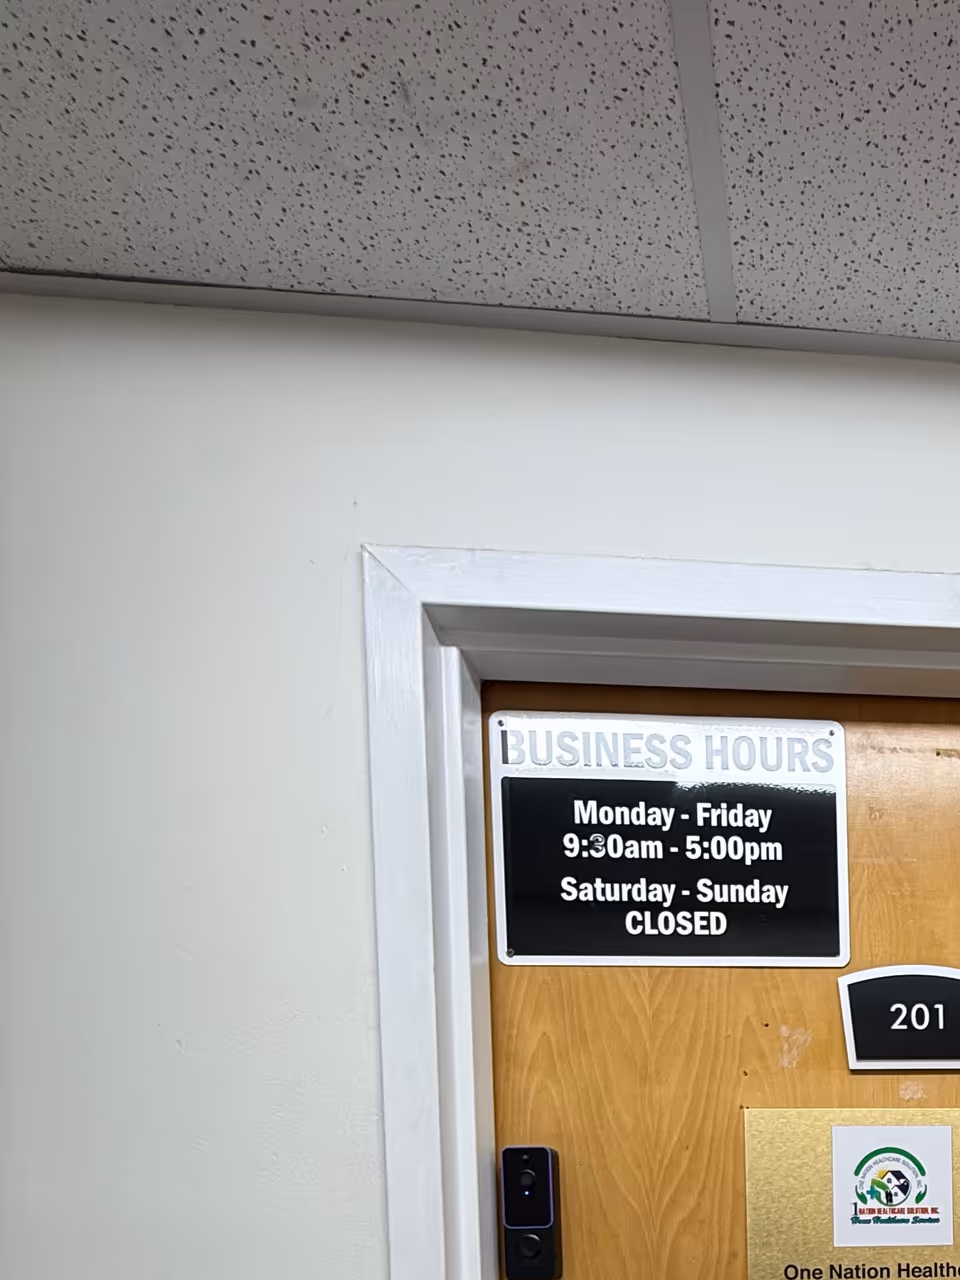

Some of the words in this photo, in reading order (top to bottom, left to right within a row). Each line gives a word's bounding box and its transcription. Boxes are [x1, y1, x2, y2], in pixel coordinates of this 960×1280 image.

[500, 729, 693, 770] BUSINESS
[705, 734, 834, 773] HOURS
[573, 800, 675, 831] Monday
[696, 802, 772, 833] Friday
[562, 833, 664, 860] 9:30am
[685, 836, 783, 865] 5:00pm
[560, 876, 676, 907] Saturday
[696, 878, 790, 909] Sunday
[625, 911, 728, 936] CLOSED
[889, 1003, 945, 1031] 201
[783, 1264, 824, 1280] One
[829, 1263, 891, 1280] Nation
